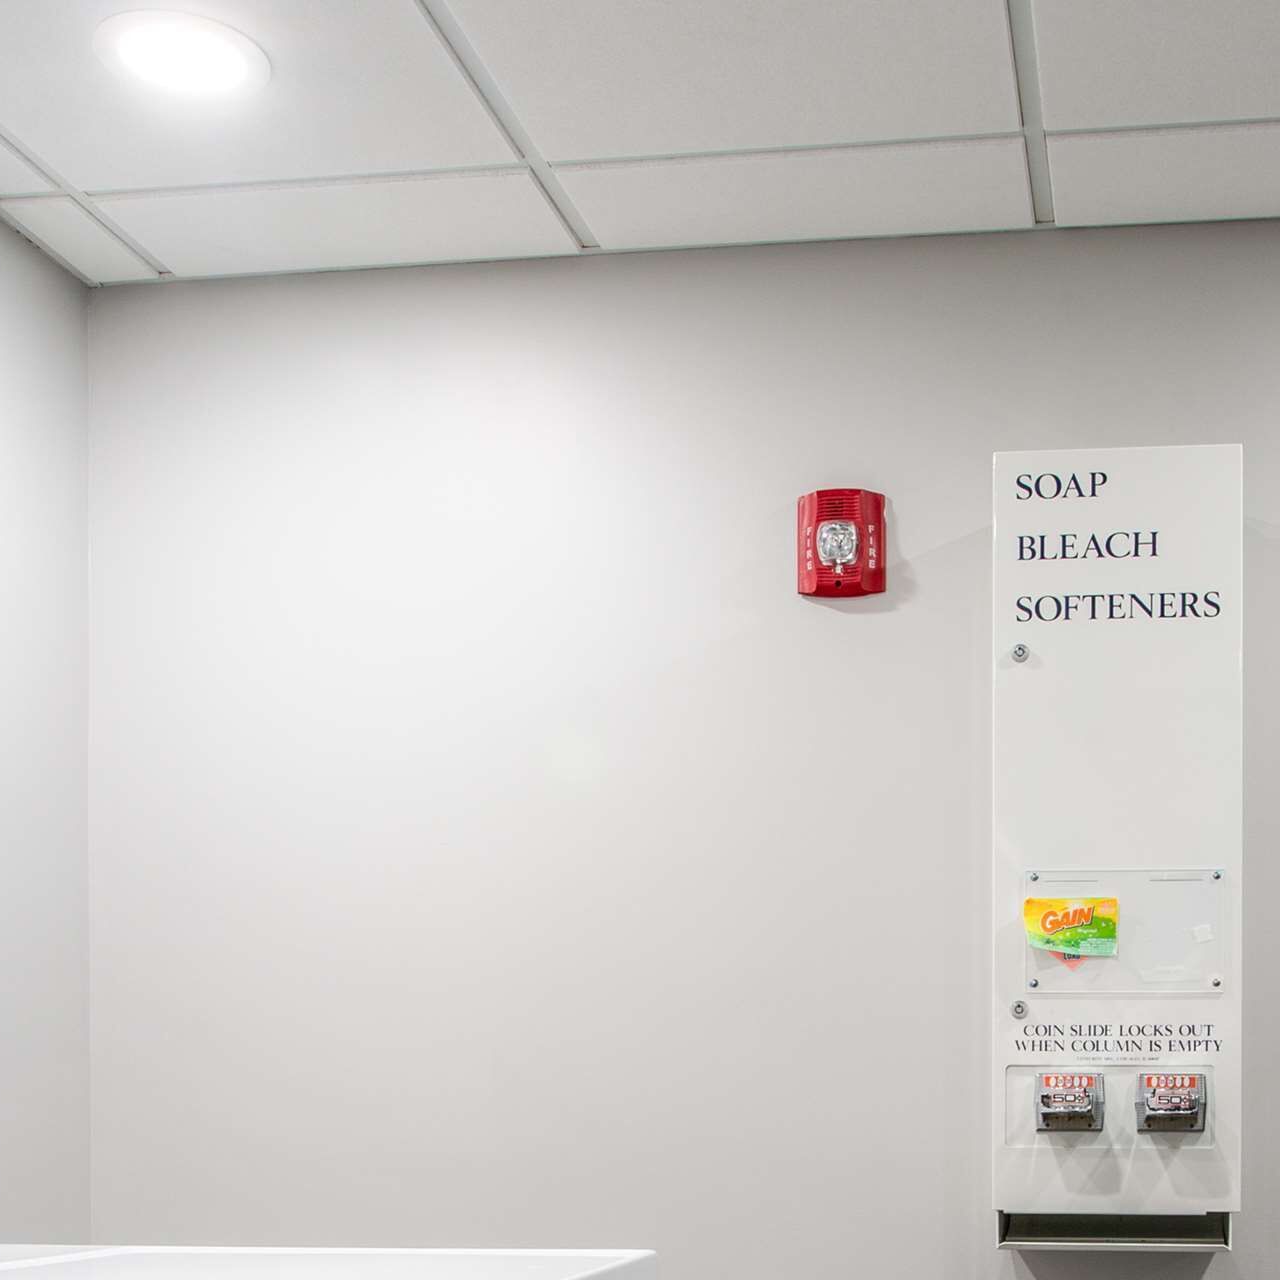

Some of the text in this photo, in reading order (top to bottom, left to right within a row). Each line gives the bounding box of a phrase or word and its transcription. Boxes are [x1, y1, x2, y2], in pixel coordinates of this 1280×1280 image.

[1015, 471, 1108, 501] SOAP
[806, 526, 814, 571] FIRE
[868, 524, 877, 569] FIRE
[1017, 531, 1159, 561] BLEACH
[1015, 591, 1221, 622] SOFTENERS
[1040, 905, 1095, 935] GAIN
[1015, 1039, 1223, 1052] WHEN COLUMN IS EMPTY
[1023, 1024, 1214, 1037] COIN SLIDE LOCKS OUT
